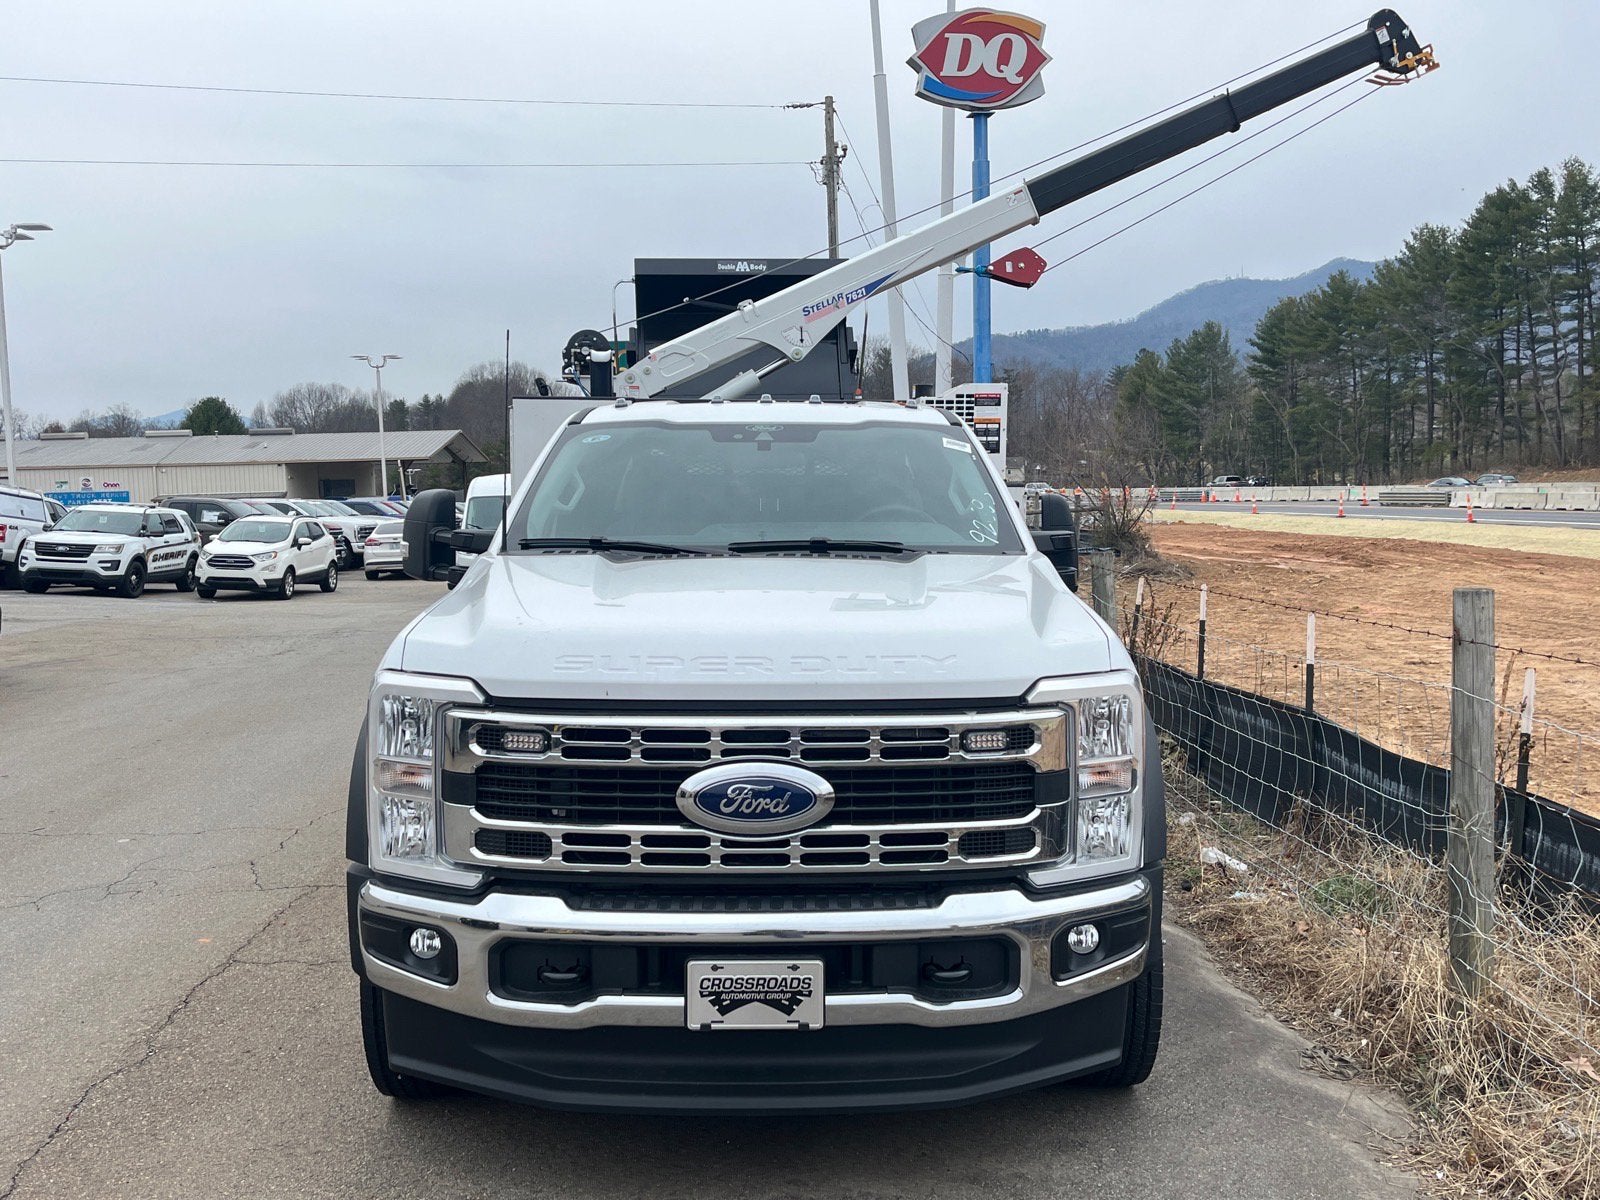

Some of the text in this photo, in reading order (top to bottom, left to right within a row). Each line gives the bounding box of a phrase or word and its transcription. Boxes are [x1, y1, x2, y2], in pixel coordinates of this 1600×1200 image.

[940, 33, 1028, 85] DQ
[750, 264, 767, 272] Body
[802, 288, 867, 317] STELLAR 7621
[151, 550, 188, 563] SHERIFF
[552, 654, 958, 675] SUPER DUTY
[719, 783, 790, 814] Ford
[699, 976, 812, 991] CROSSROADS
[720, 992, 792, 1000] AUTOMOTIVE GROUP
